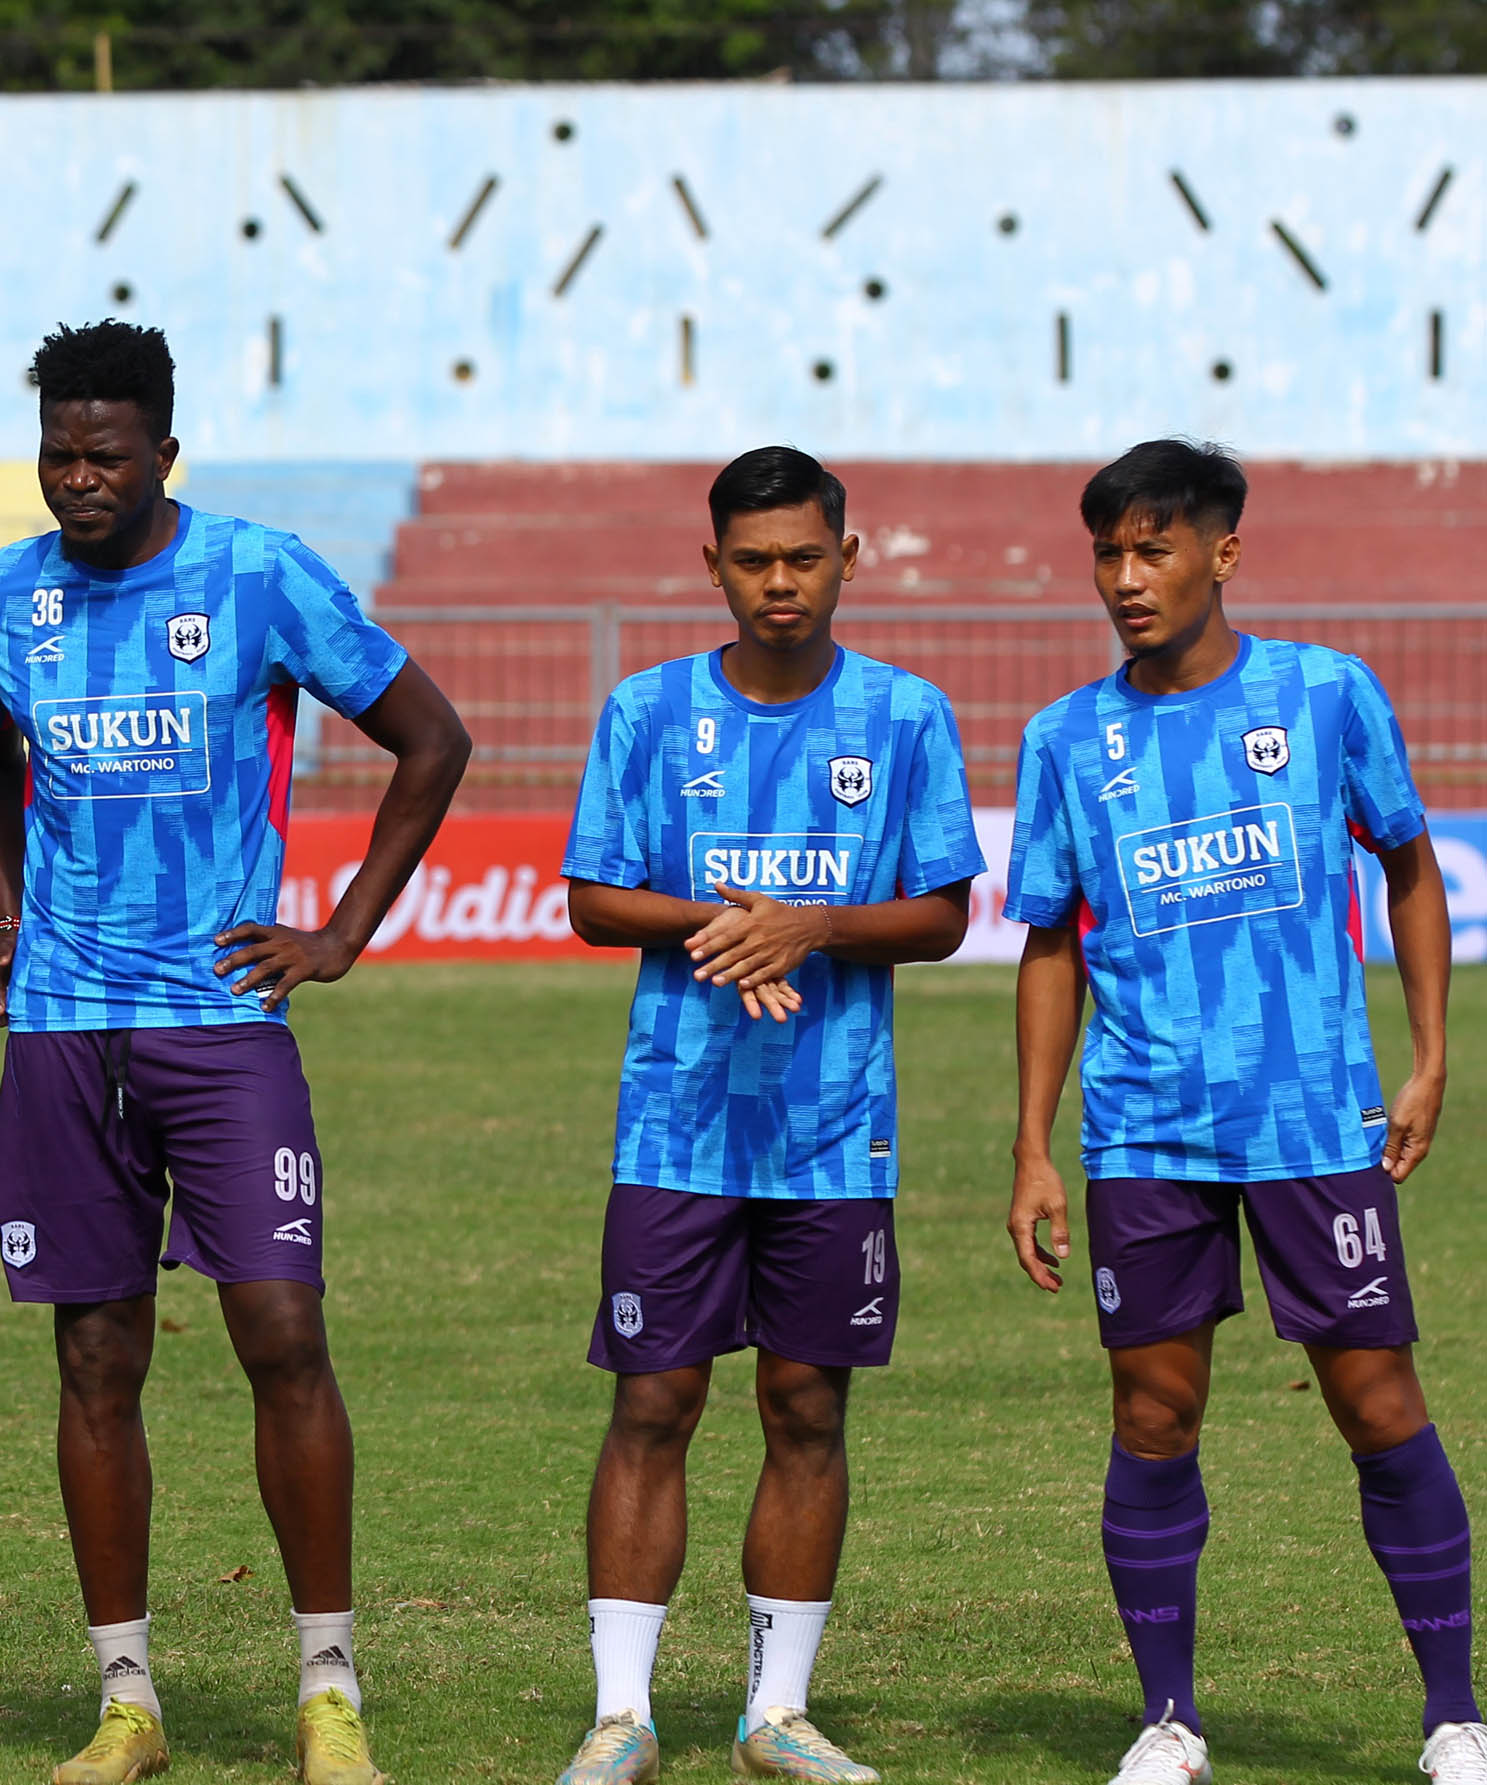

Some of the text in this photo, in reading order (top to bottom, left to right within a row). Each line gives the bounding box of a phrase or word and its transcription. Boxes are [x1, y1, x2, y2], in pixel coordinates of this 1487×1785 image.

[31, 588, 65, 627] 36
[25, 653, 65, 664] HUNDRED
[47, 707, 192, 751] SUKUN
[696, 717, 715, 754] 9
[1105, 722, 1126, 761] 5
[70, 757, 175, 775] Mc. WARTONO
[680, 787, 726, 798] HUNDRED
[1098, 783, 1141, 803] HUNDRED
[704, 848, 850, 886] SUKUN
[1132, 820, 1280, 886] SUKUN
[1160, 872, 1266, 906] Mc. WARTONO
[273, 1147, 317, 1206] 99
[273, 1231, 313, 1246] HUNDRED
[1333, 1207, 1387, 1269] 64
[862, 1229, 886, 1285] 19
[305, 1656, 350, 1669] adidas
